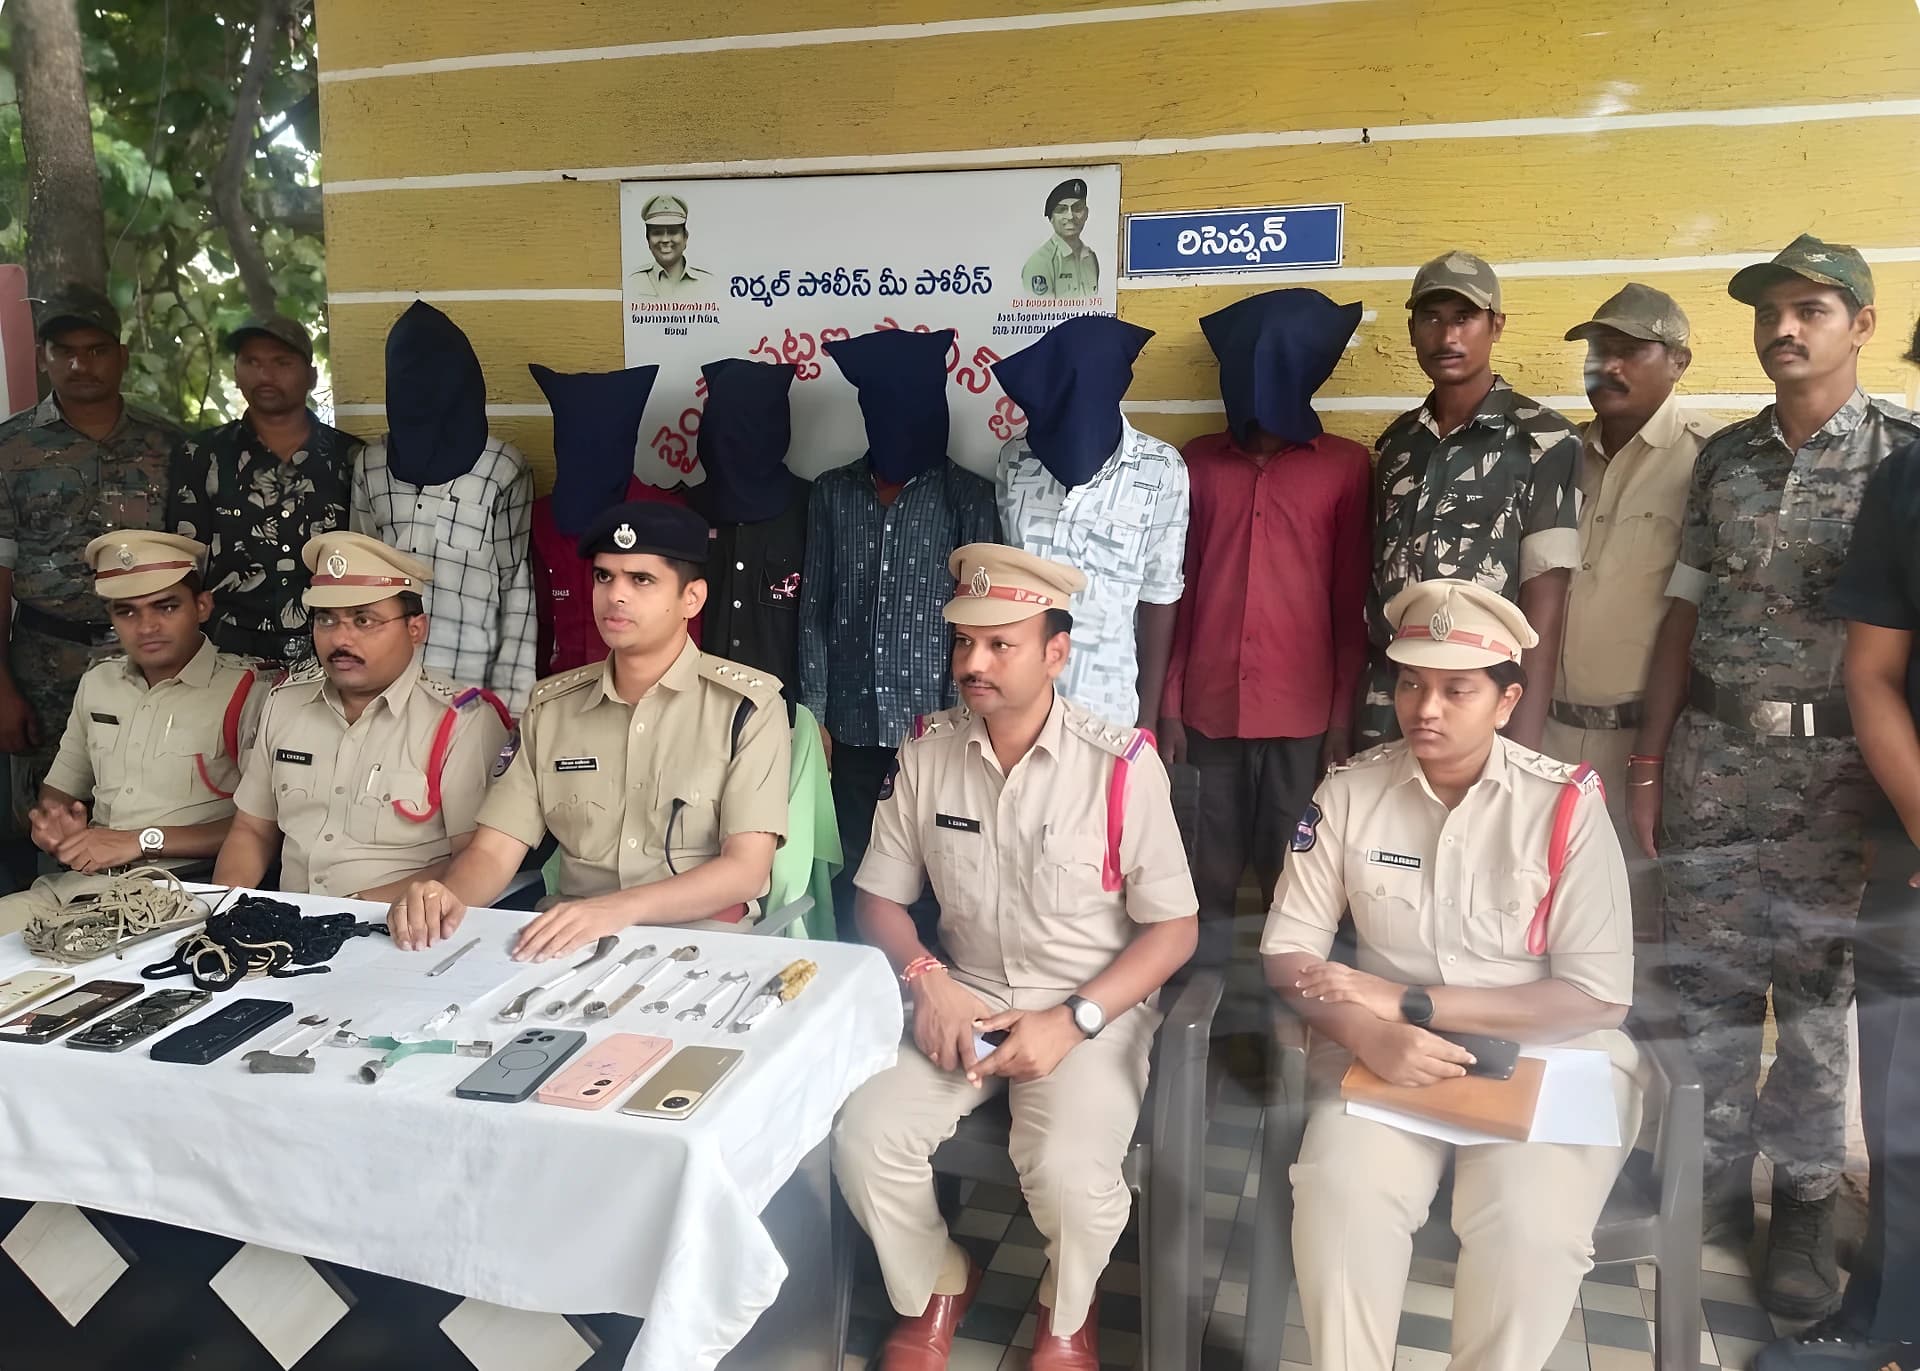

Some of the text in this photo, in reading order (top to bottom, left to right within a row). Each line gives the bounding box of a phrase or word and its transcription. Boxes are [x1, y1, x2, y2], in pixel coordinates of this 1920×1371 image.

[1177, 216, 1288, 262] రిసెప్షన్
[730, 264, 992, 307] నిర్మల్ పోలీస్ మీ పోలీస్
